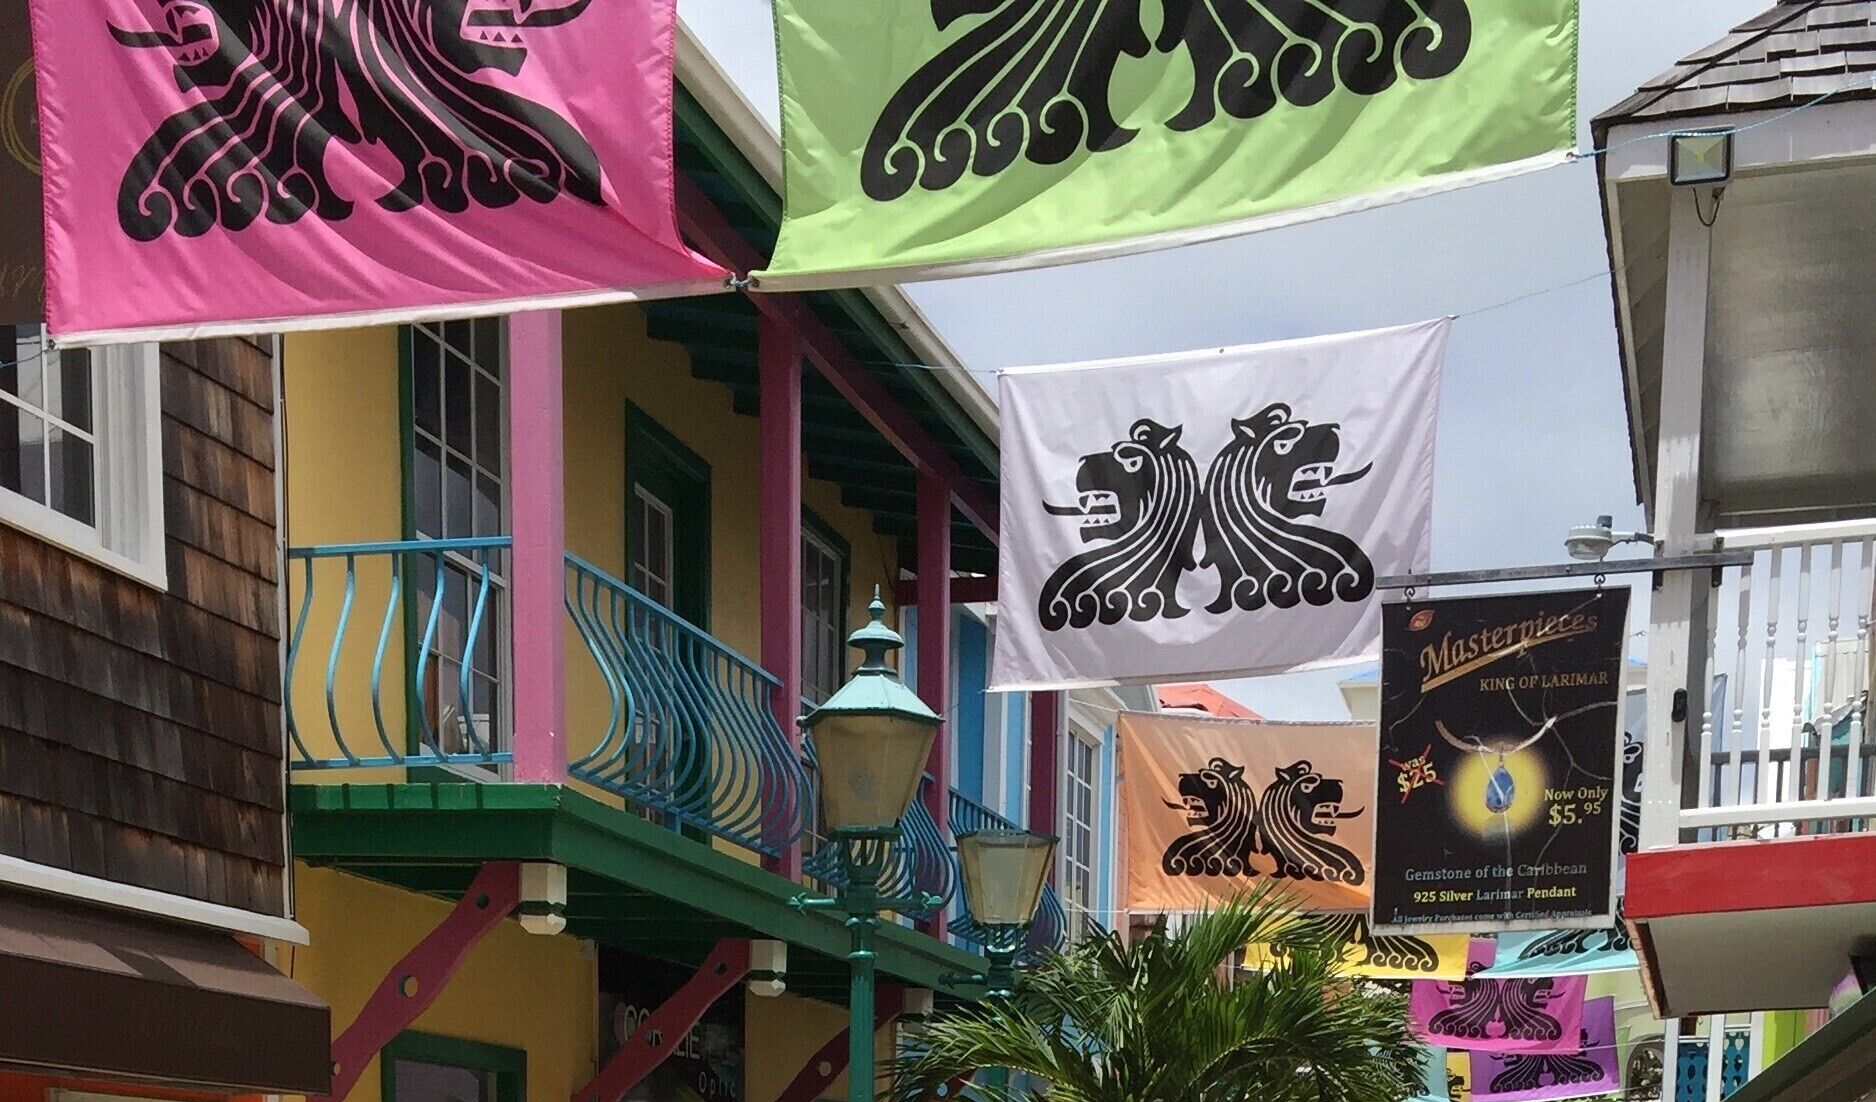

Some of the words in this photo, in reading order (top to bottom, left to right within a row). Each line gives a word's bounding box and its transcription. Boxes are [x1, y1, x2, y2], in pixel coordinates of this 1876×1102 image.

[1420, 610, 1598, 682] Masterpieces
[1479, 676, 1515, 692] KING
[1519, 674, 1537, 689] OF
[1542, 671, 1609, 688] LARIMAR
[1402, 755, 1426, 771] was
[1397, 761, 1437, 793] $25
[1544, 788, 1574, 801] Now
[1577, 785, 1609, 801] Only
[1405, 867, 1472, 882] Gemstone
[1475, 865, 1490, 879] of
[1492, 865, 1514, 878] the
[1517, 863, 1588, 878] Caribbean
[1413, 891, 1436, 903] 925
[1439, 889, 1474, 902] Silver
[1476, 888, 1525, 901] Larimar
[1526, 886, 1577, 899] Pendant
